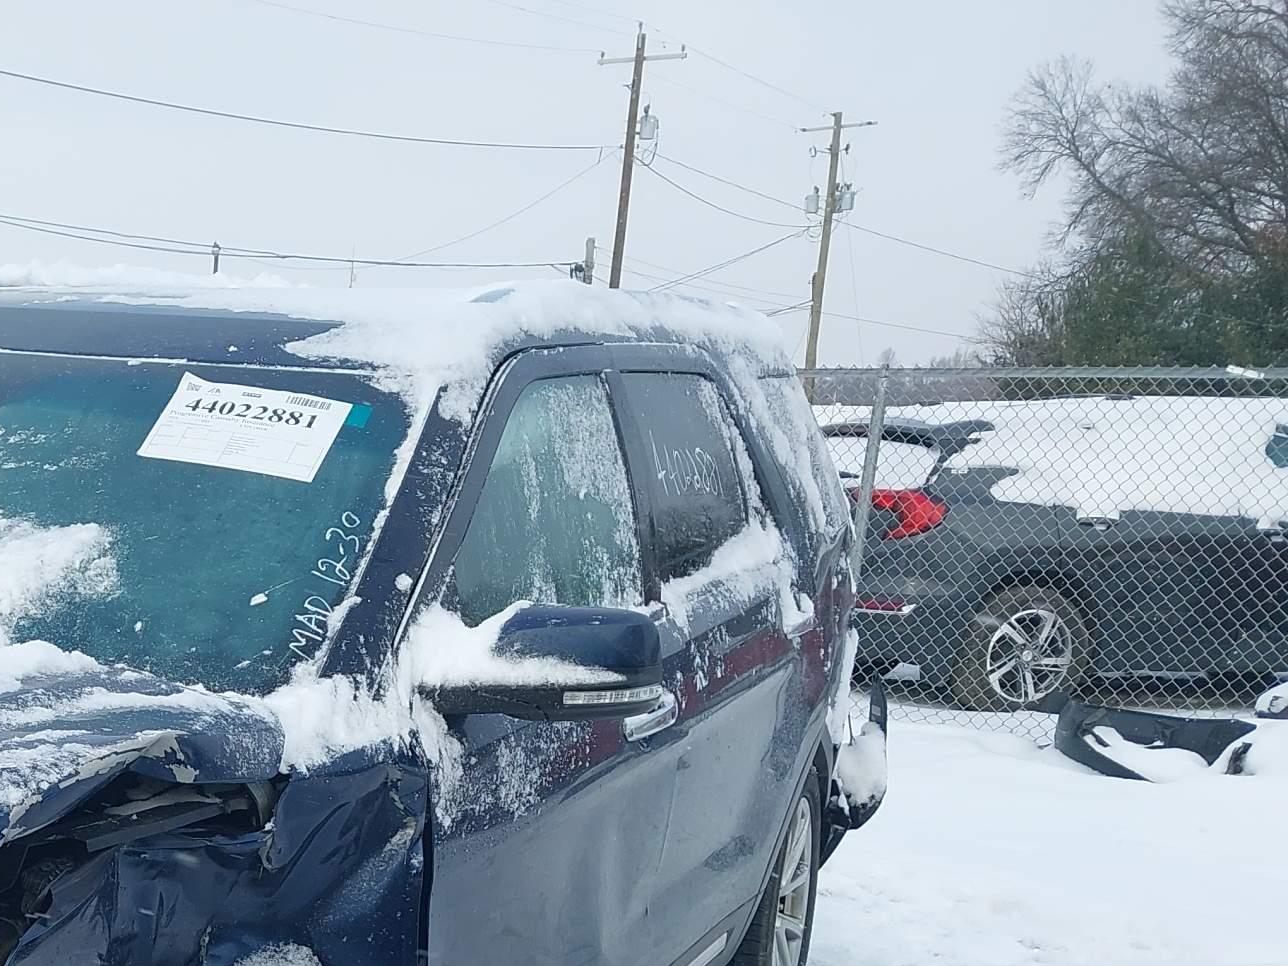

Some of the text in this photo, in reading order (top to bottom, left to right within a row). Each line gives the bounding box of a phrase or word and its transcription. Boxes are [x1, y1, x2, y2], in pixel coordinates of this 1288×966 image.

[185, 398, 318, 429] 44022881
[289, 511, 361, 661] MAD 12-30
